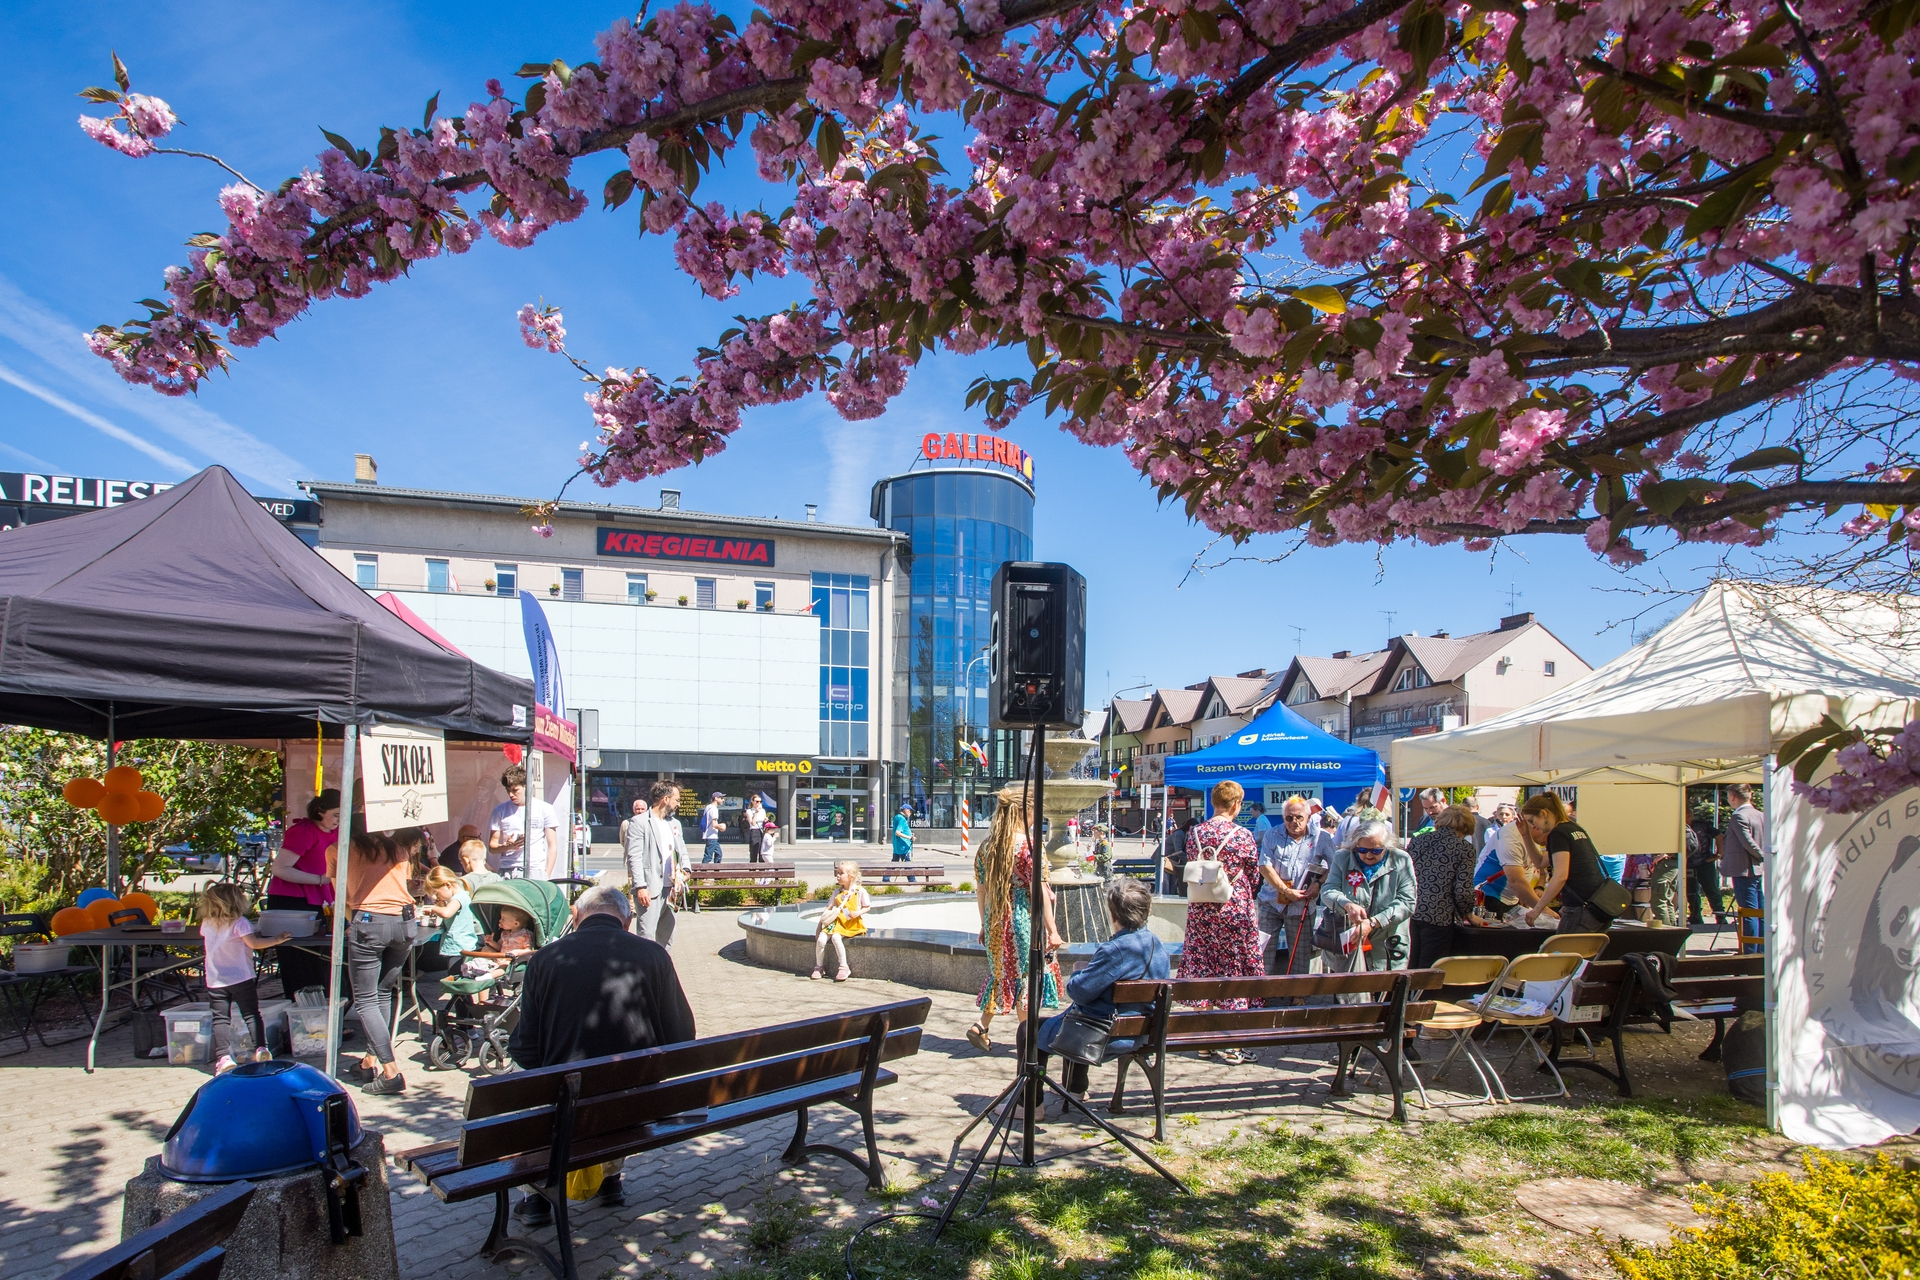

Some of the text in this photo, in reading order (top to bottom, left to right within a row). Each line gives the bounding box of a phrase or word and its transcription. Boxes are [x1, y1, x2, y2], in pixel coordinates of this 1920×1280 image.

[922, 432, 1022, 471] GALERIA
[259, 502, 296, 516] VED
[604, 532, 768, 562] KRĘGIELNIA
[545, 714, 559, 741] Ziemi
[381, 743, 435, 787] SZKOŁA
[756, 760, 796, 772] Netto
[1197, 761, 1341, 773] Razem tworzymy miasto
[910, 820, 930, 828] FASHION
